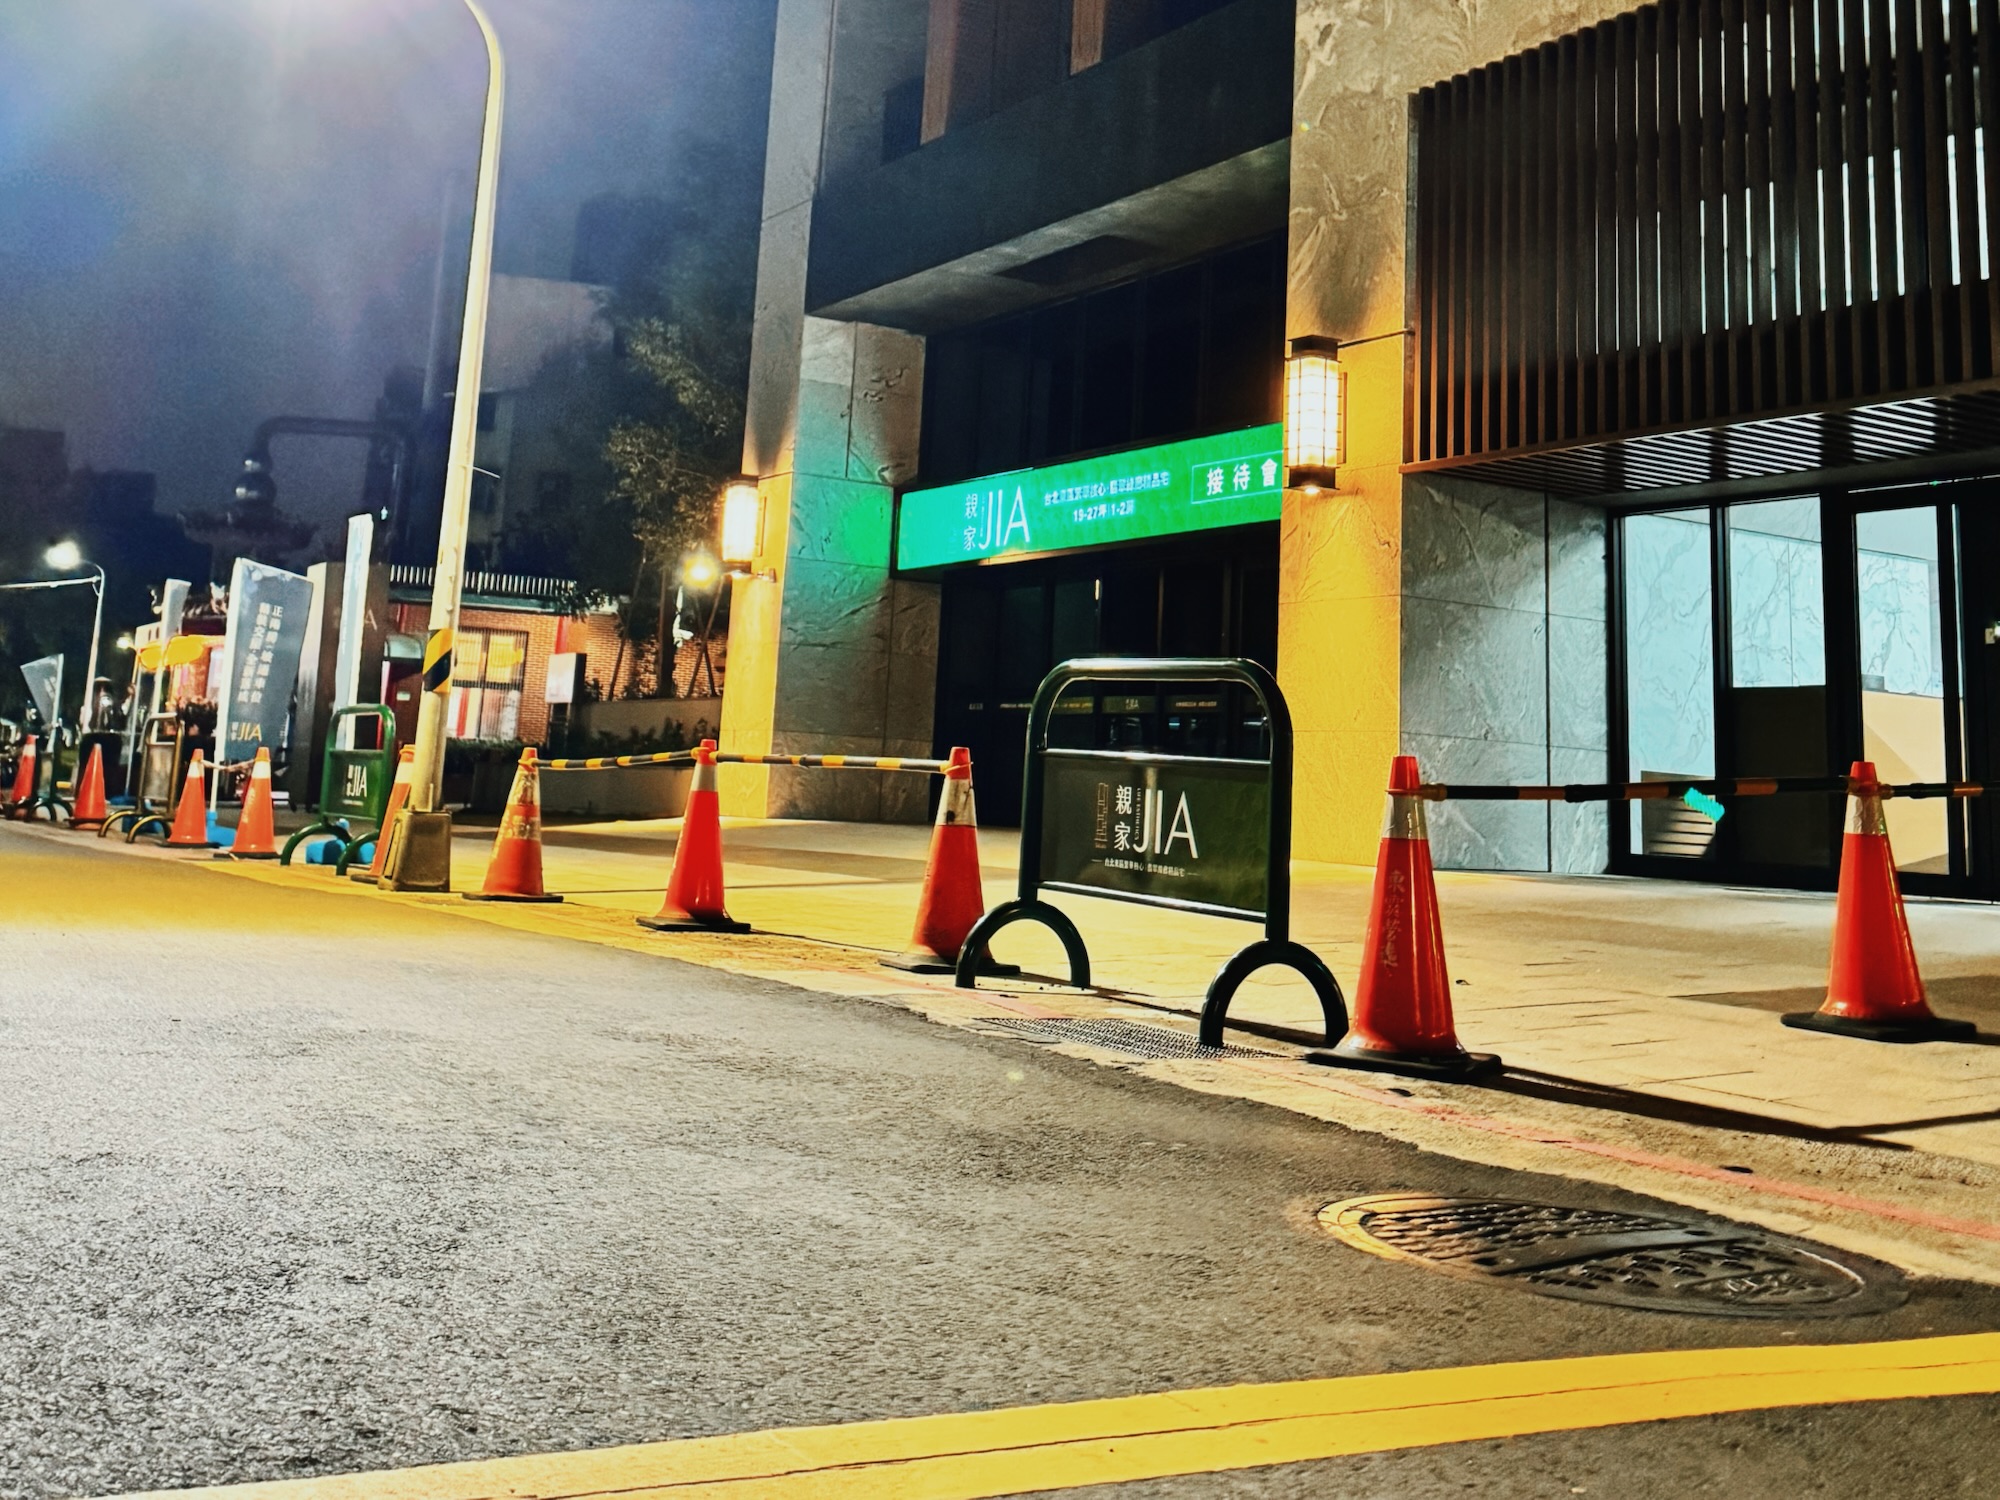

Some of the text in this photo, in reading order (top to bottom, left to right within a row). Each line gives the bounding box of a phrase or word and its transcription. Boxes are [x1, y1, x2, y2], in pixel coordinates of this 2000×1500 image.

[1206, 458, 1278, 496] 接待會
[963, 493, 978, 551] 親家
[978, 486, 1031, 549] JIA
[1114, 785, 1132, 851] 親家
[1133, 788, 1199, 859] JIA
